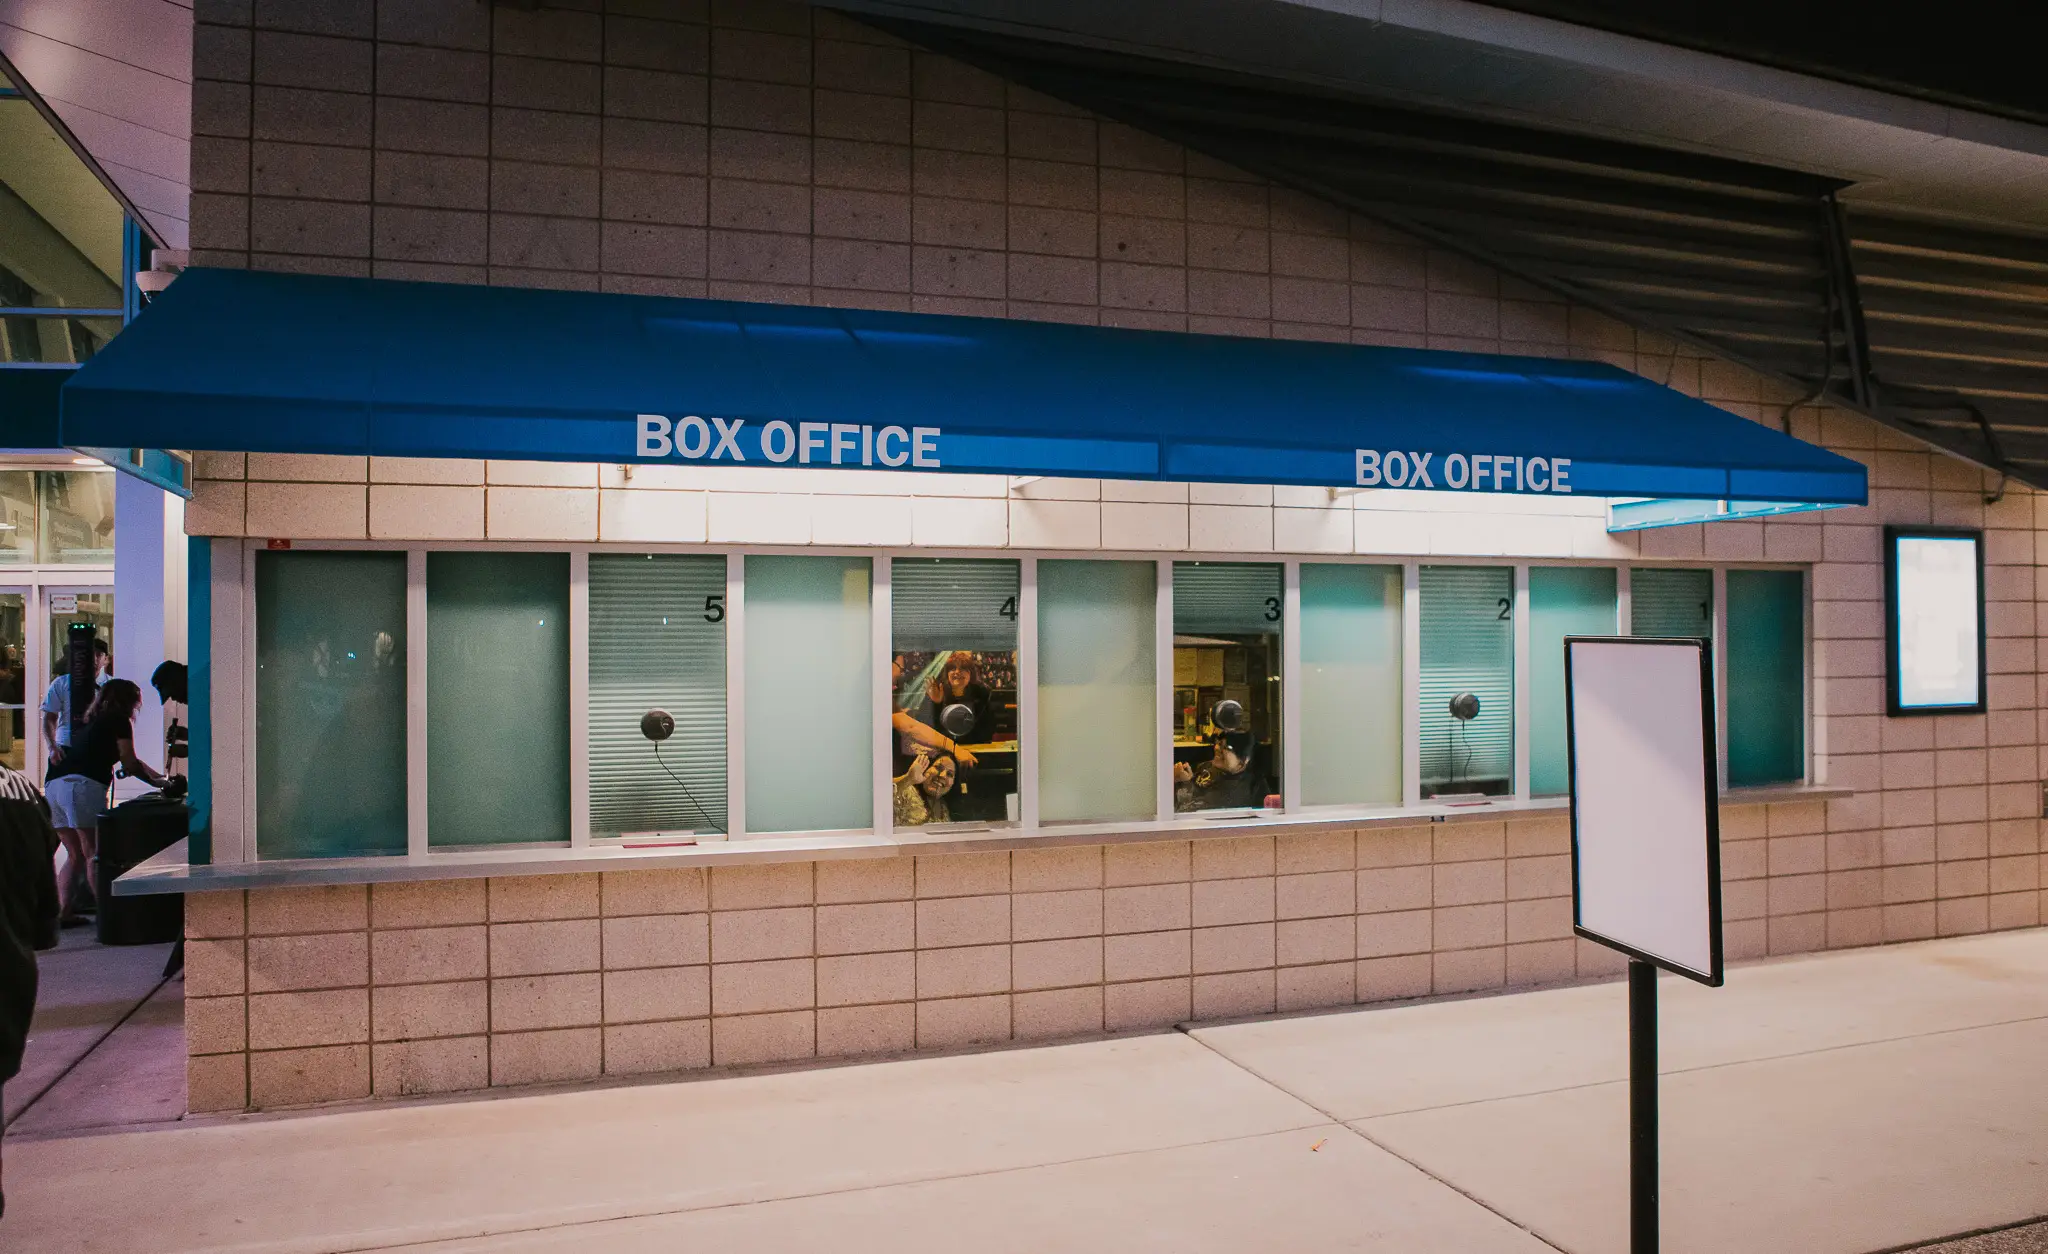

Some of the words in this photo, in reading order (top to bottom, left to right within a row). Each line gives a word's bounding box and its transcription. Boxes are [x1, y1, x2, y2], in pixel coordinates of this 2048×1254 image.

[636, 414, 746, 461] BOX
[760, 420, 941, 468] OFFICE
[1355, 448, 1434, 488] BOX
[1444, 453, 1572, 493] OFFICE
[703, 595, 725, 623] 5
[999, 596, 1019, 621] 4
[1264, 597, 1281, 622] 3
[1497, 597, 1511, 621] 2
[1699, 601, 1708, 621] 1
